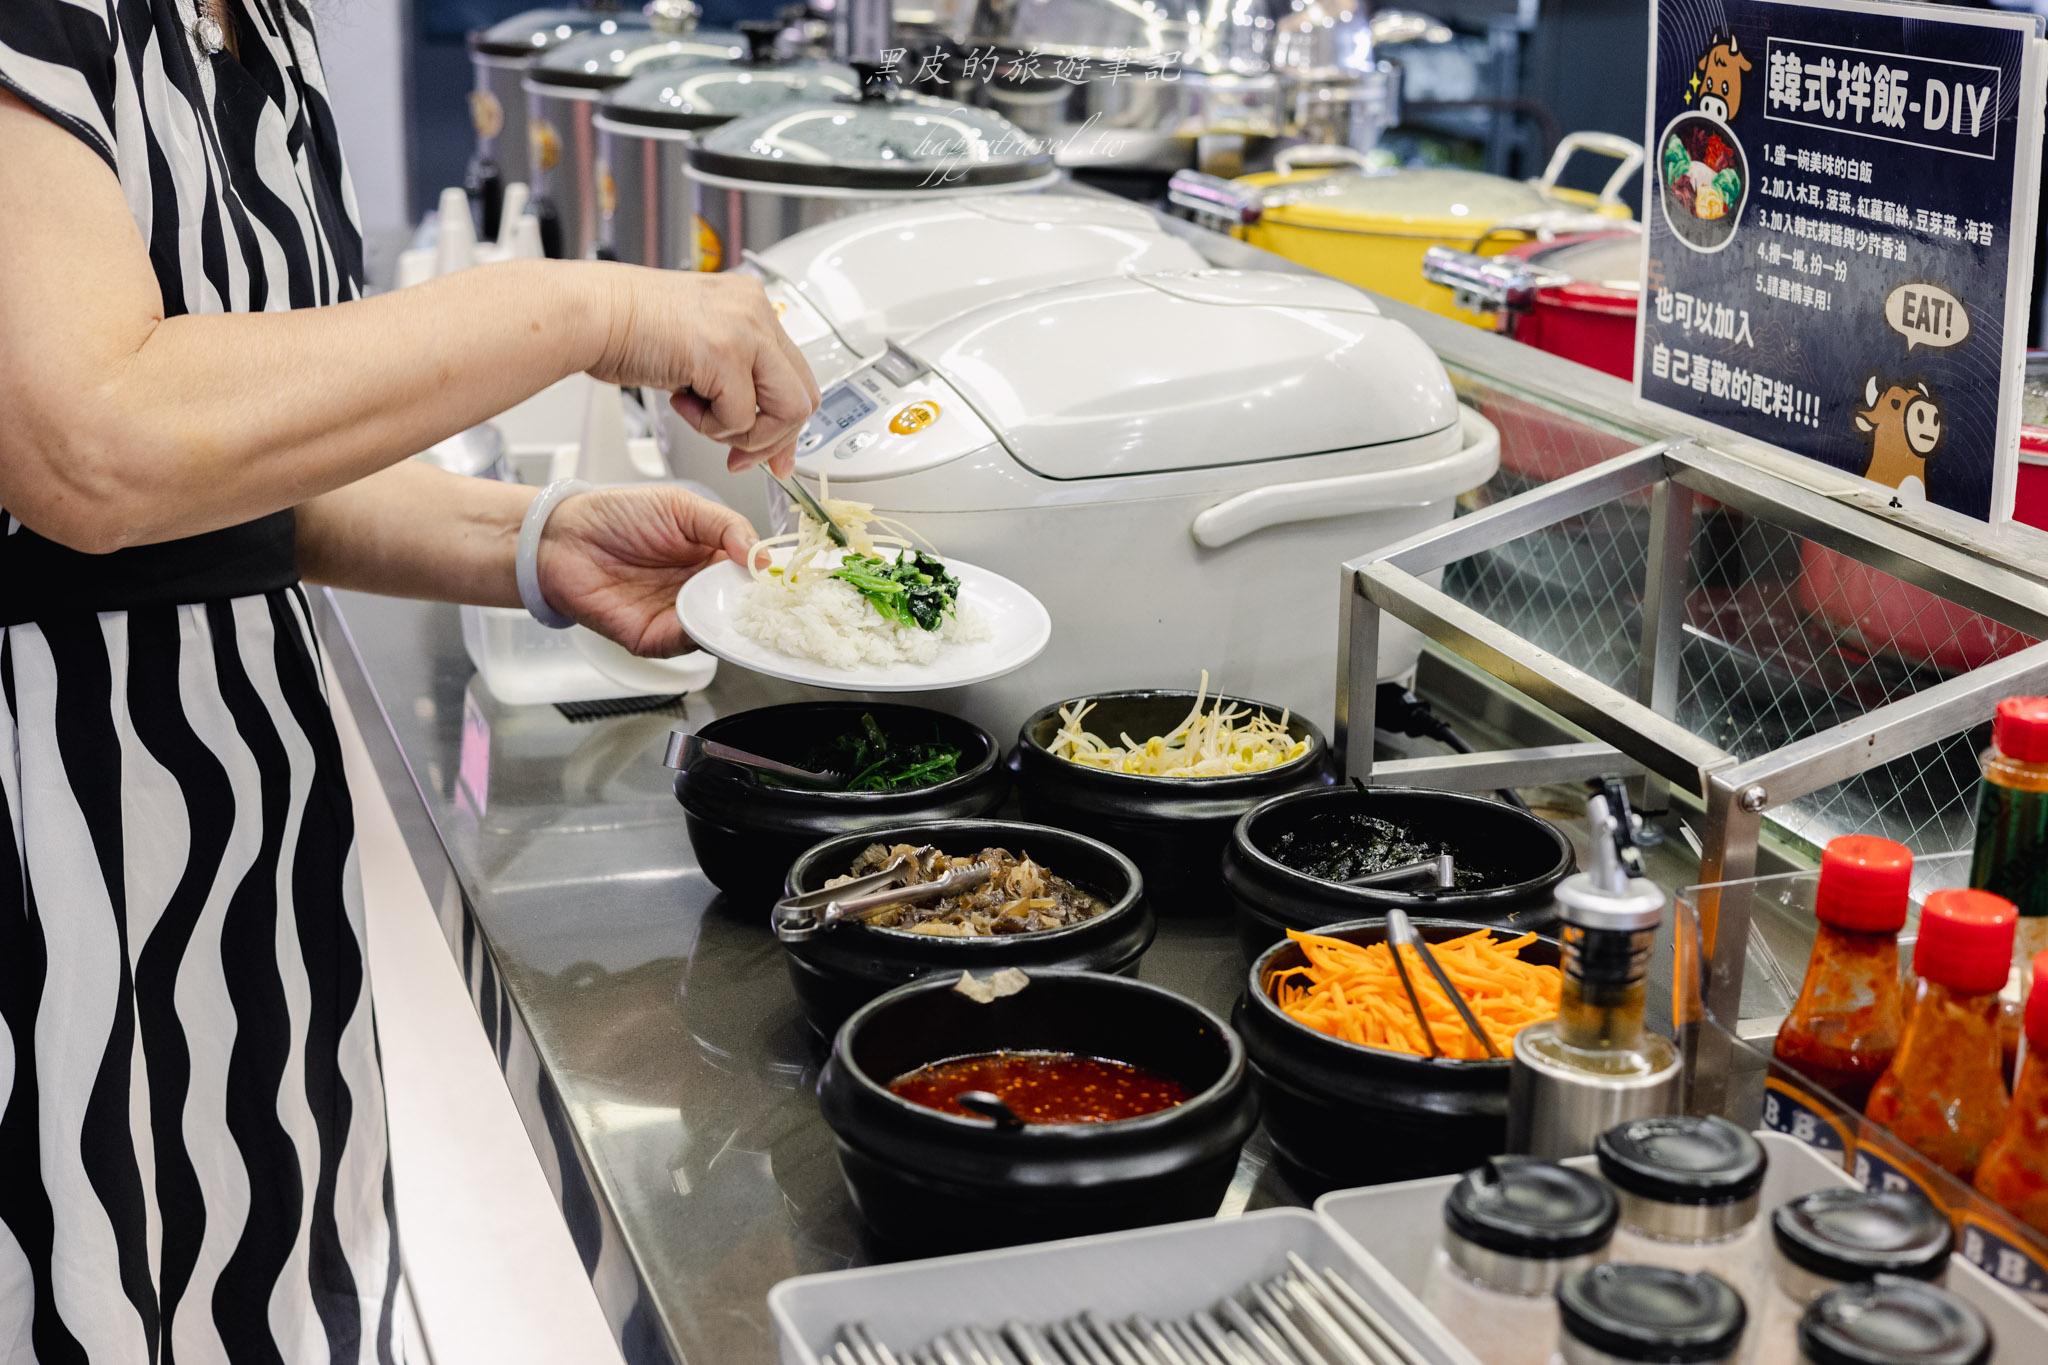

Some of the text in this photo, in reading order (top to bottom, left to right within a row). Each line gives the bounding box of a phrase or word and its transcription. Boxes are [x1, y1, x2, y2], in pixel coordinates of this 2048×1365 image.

[1769, 49, 1991, 138] 韓式拌飯-DIY
[1763, 144, 1872, 184] 1.盛一碗美味的白飯
[1655, 287, 1754, 348] 也可以加入
[1902, 290, 1953, 339] EAT!
[1652, 343, 1820, 428] 自己喜歡的配料!!!
